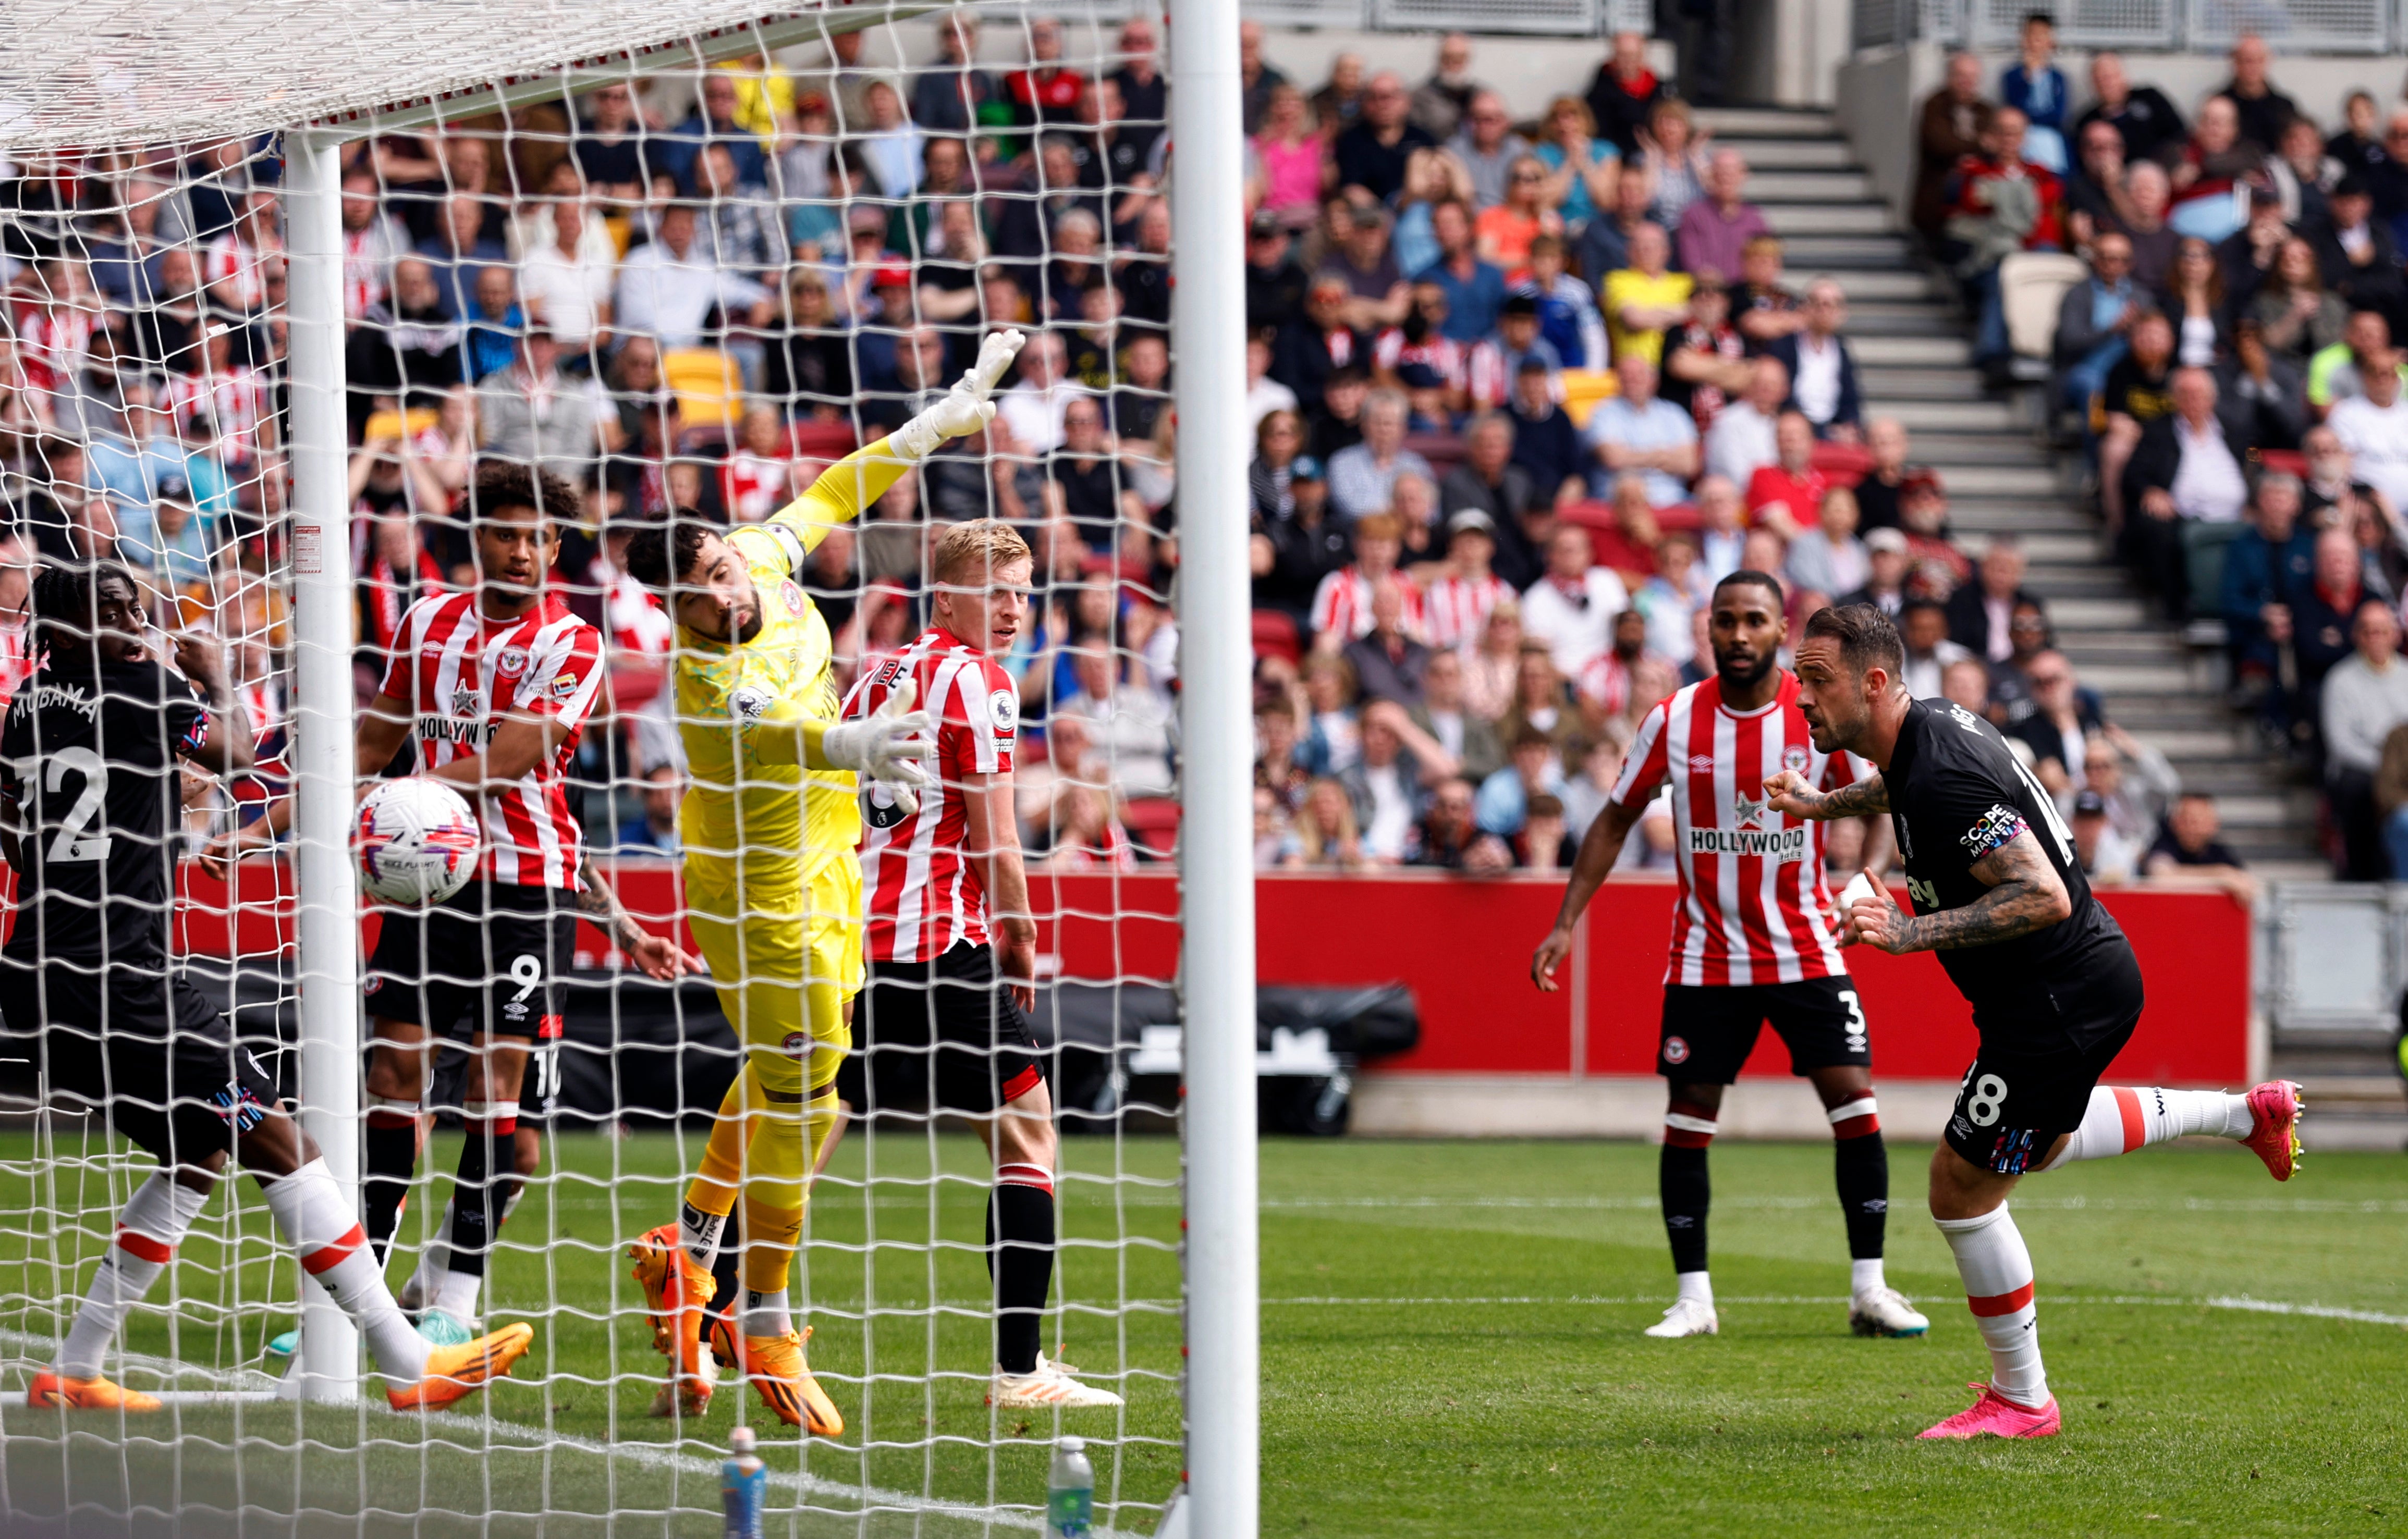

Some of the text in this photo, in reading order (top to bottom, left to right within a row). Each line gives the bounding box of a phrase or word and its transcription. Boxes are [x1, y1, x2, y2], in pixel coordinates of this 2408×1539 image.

[13, 682, 100, 729] MUBAMA
[1691, 829, 1804, 853] HOLLYWOOD
[1959, 803, 2007, 847] SCOPE
[1970, 810, 2016, 858] MARKETS
[510, 954, 542, 1002] 9
[1837, 990, 1866, 1035] 3
[1952, 1123, 1967, 1140] umbro
